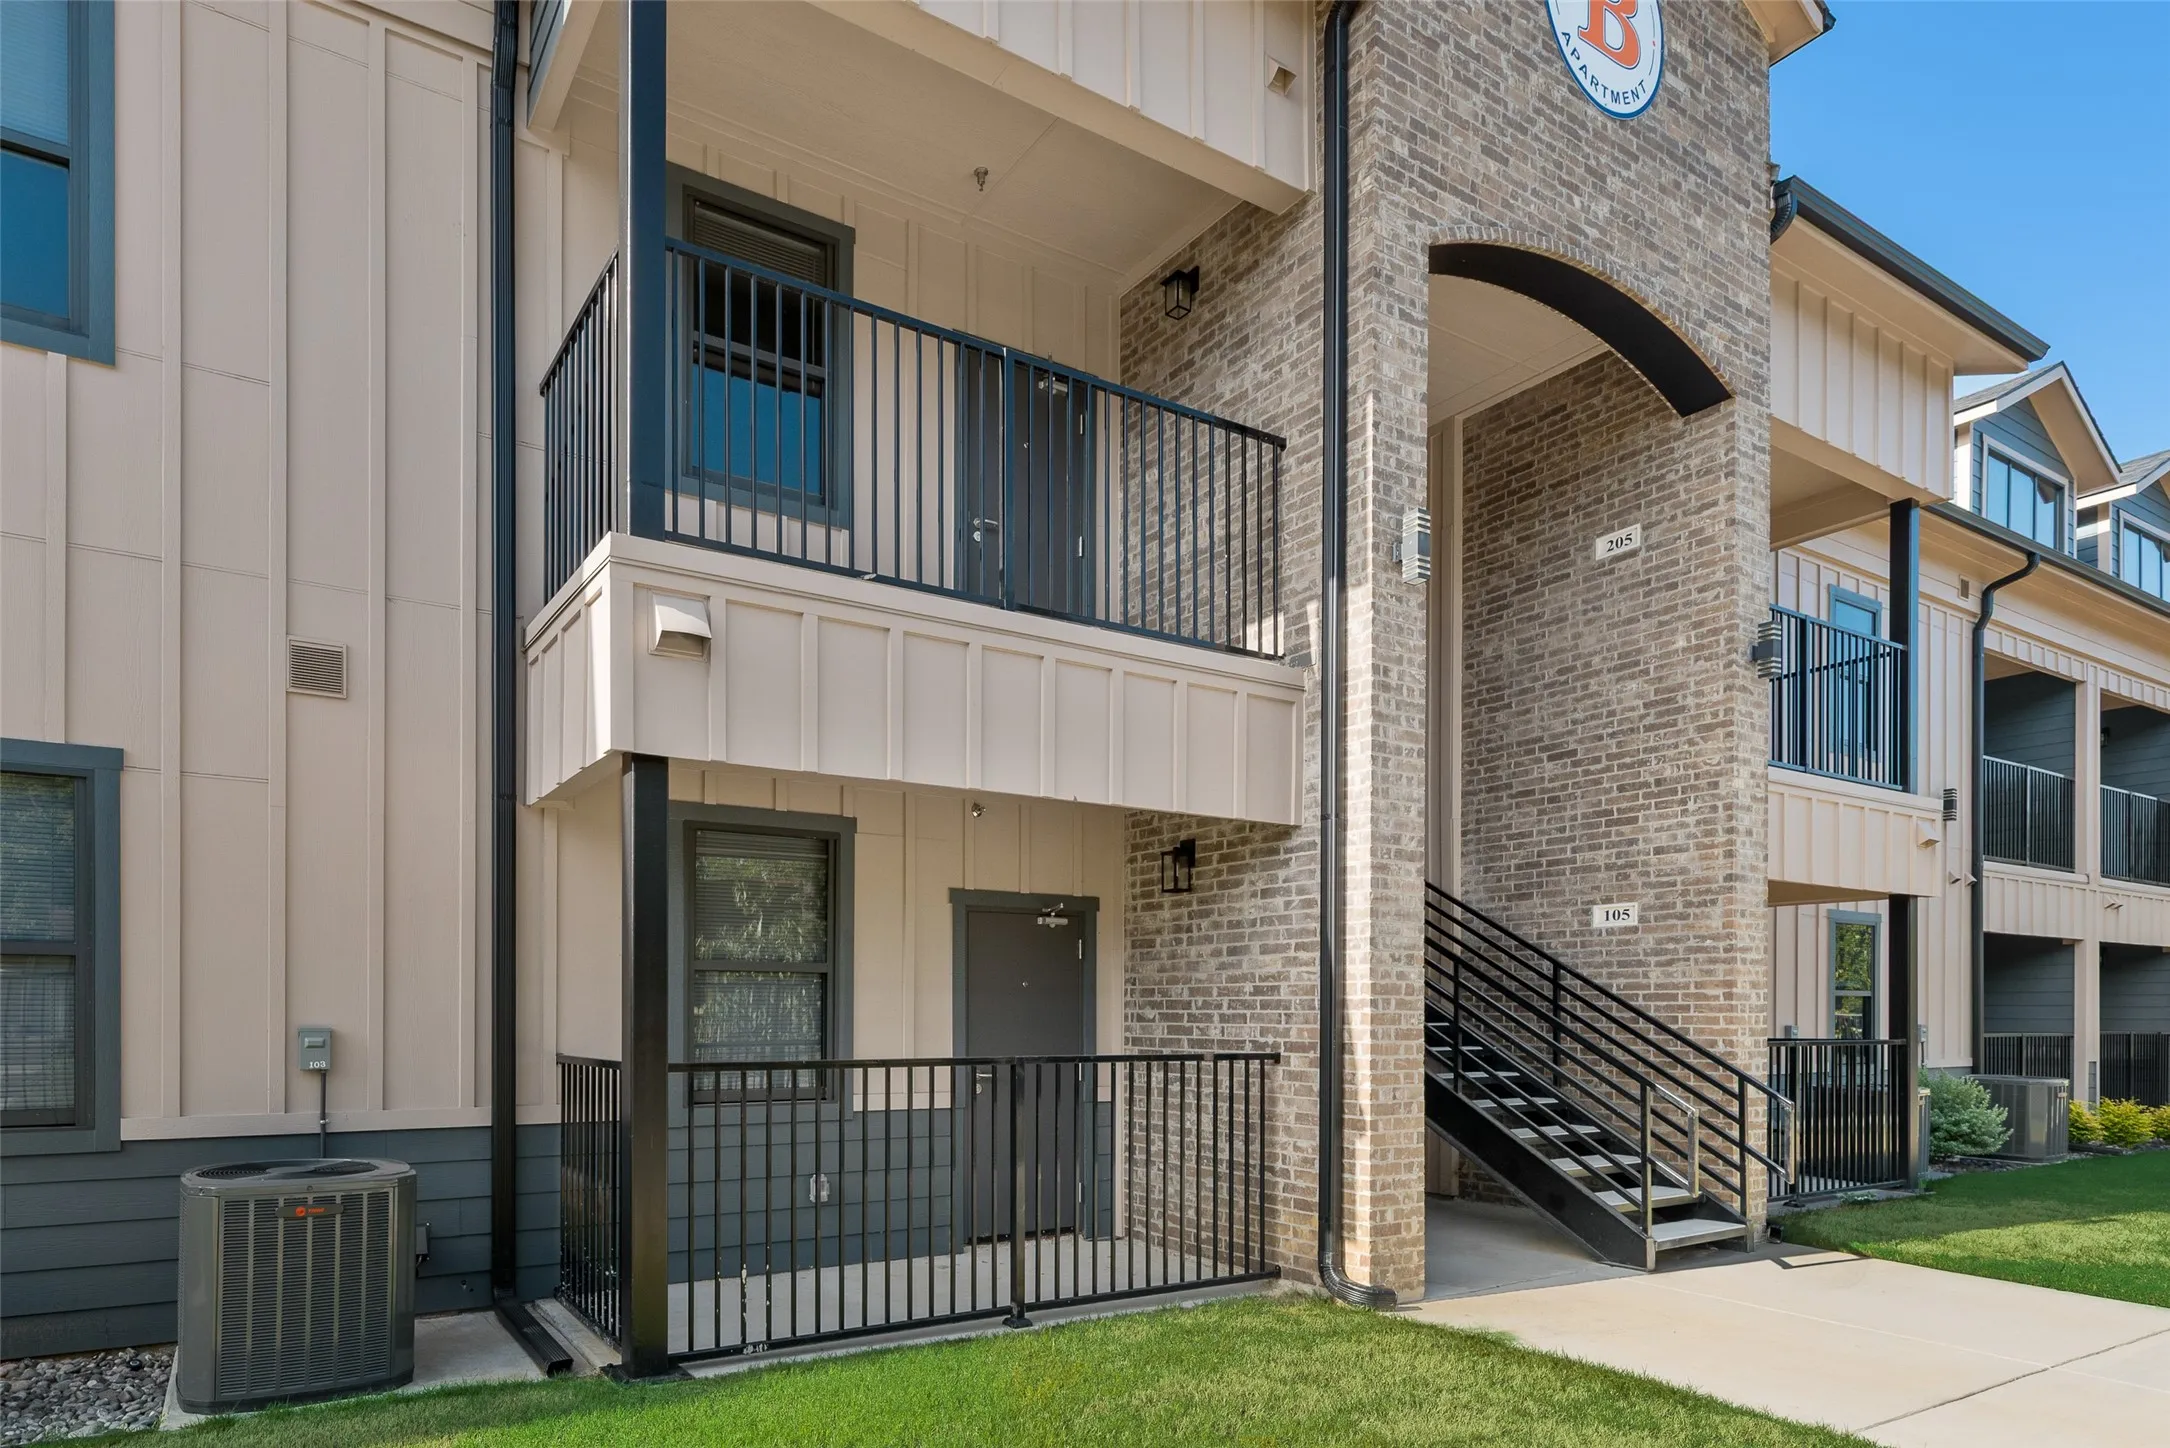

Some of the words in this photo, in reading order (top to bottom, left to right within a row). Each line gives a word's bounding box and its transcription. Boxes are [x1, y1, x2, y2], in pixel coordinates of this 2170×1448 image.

[1561, 31, 1647, 106] APARTMENT
[1606, 532, 1633, 553] 205
[1604, 908, 1631, 922] 105
[309, 1060, 326, 1069] 103
